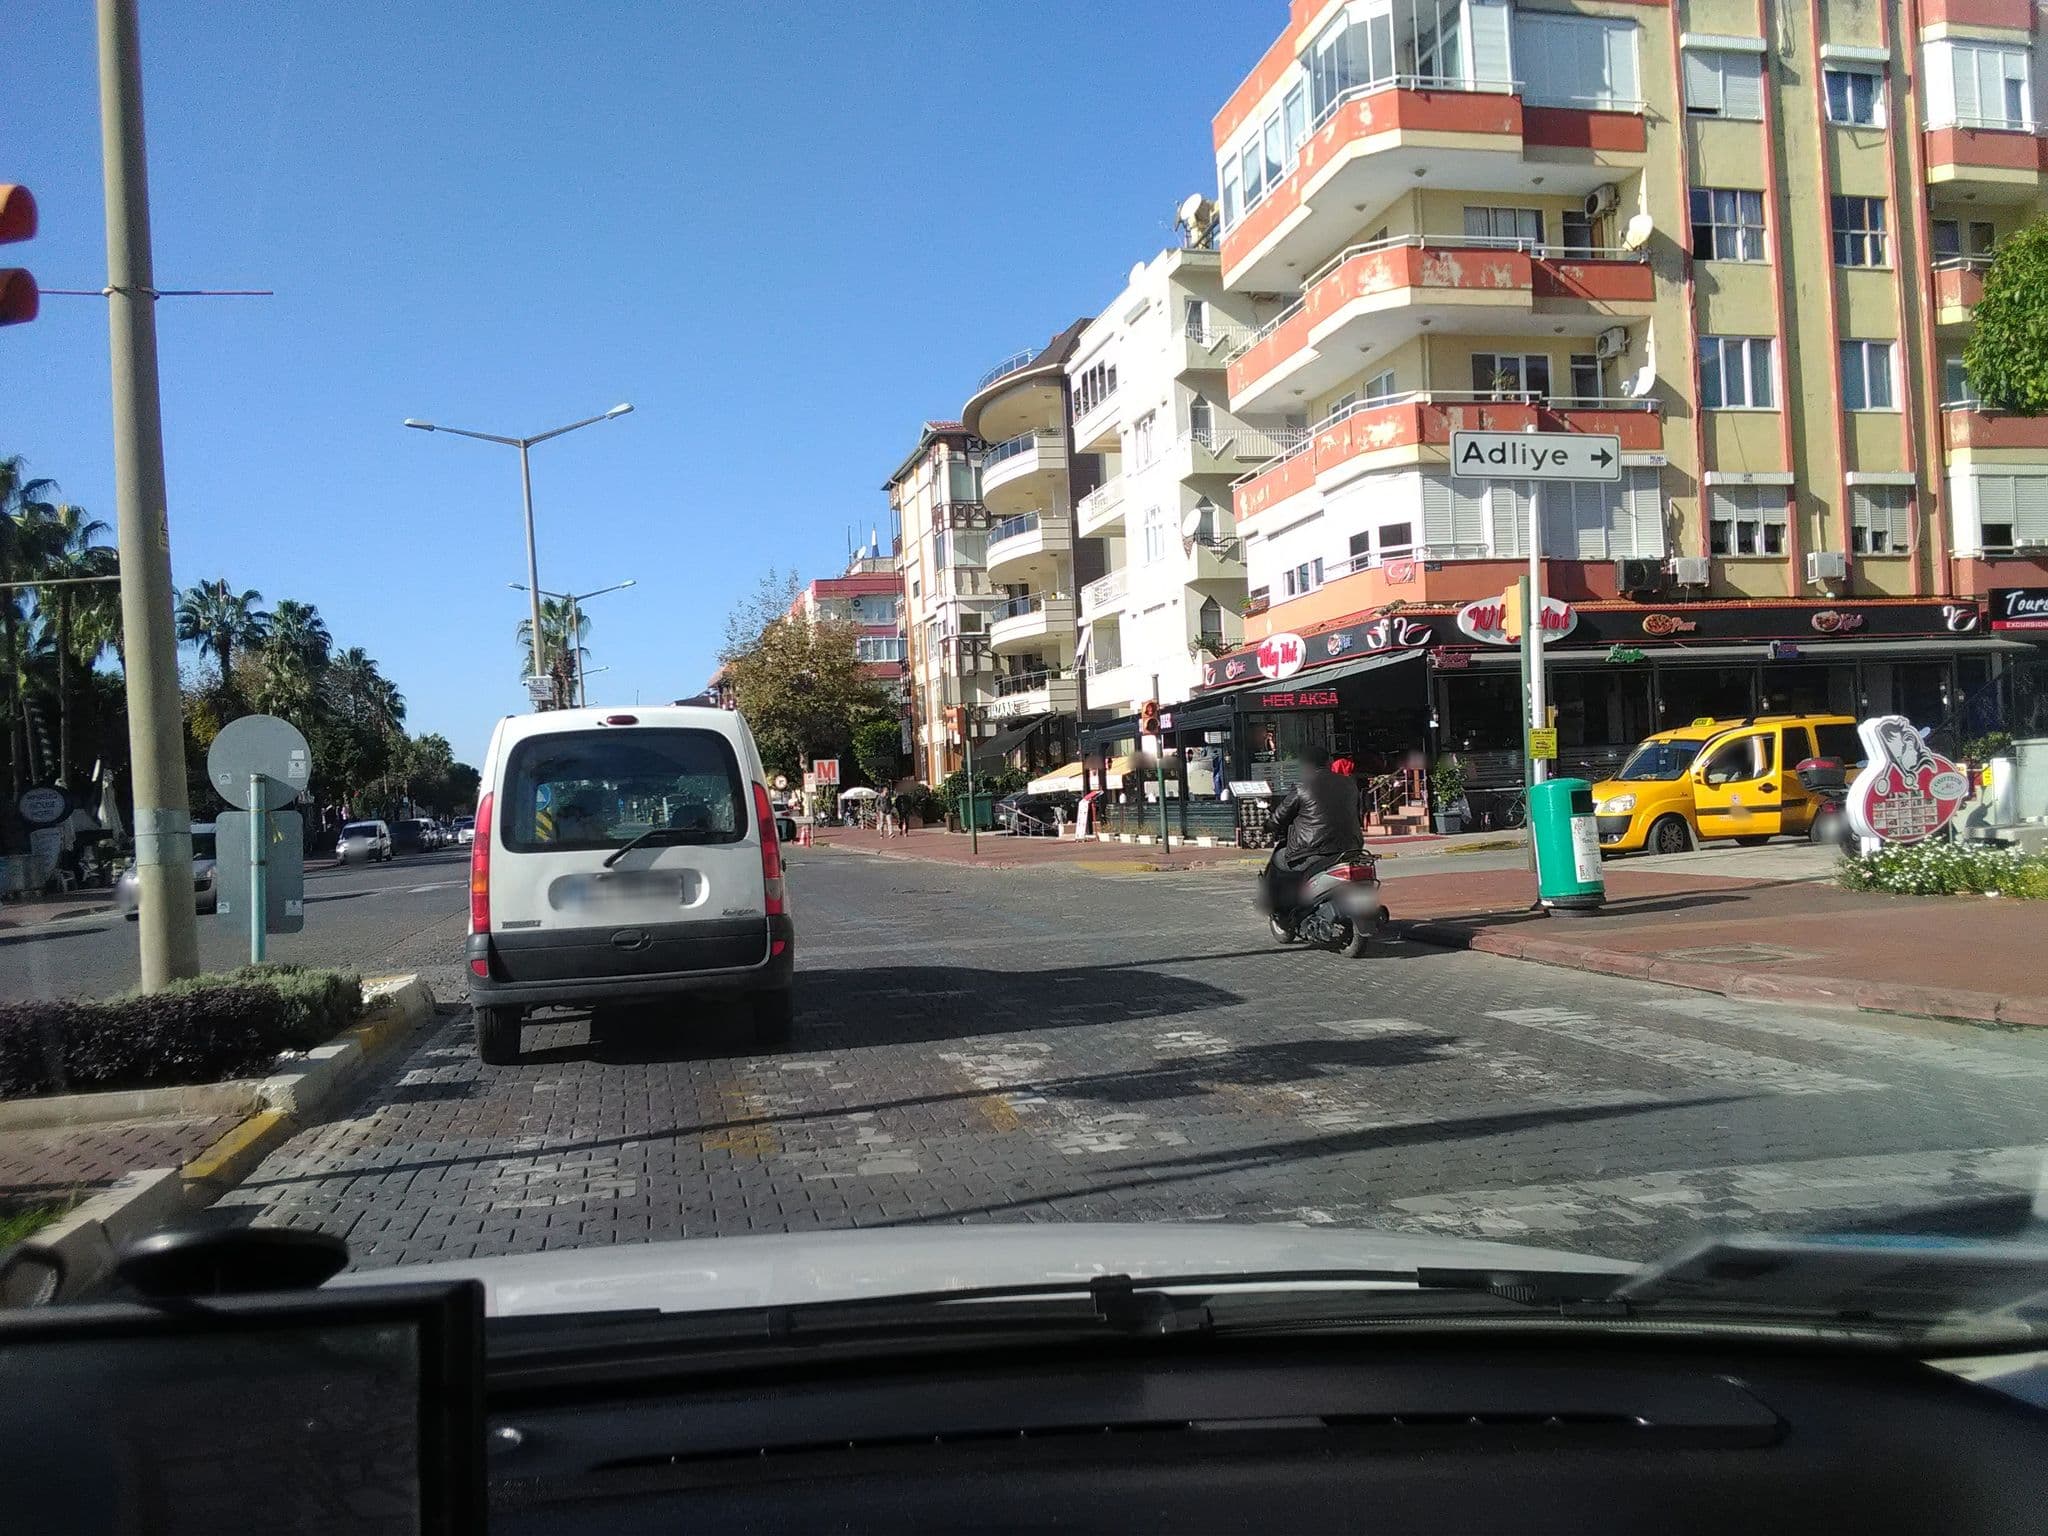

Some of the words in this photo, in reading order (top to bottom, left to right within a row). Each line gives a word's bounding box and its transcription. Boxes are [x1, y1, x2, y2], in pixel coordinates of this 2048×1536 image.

[1462, 441, 1568, 470] Adliye
[1263, 693, 1295, 707] HER
[1299, 692, 1339, 706] AKSA
[817, 761, 836, 779] M
